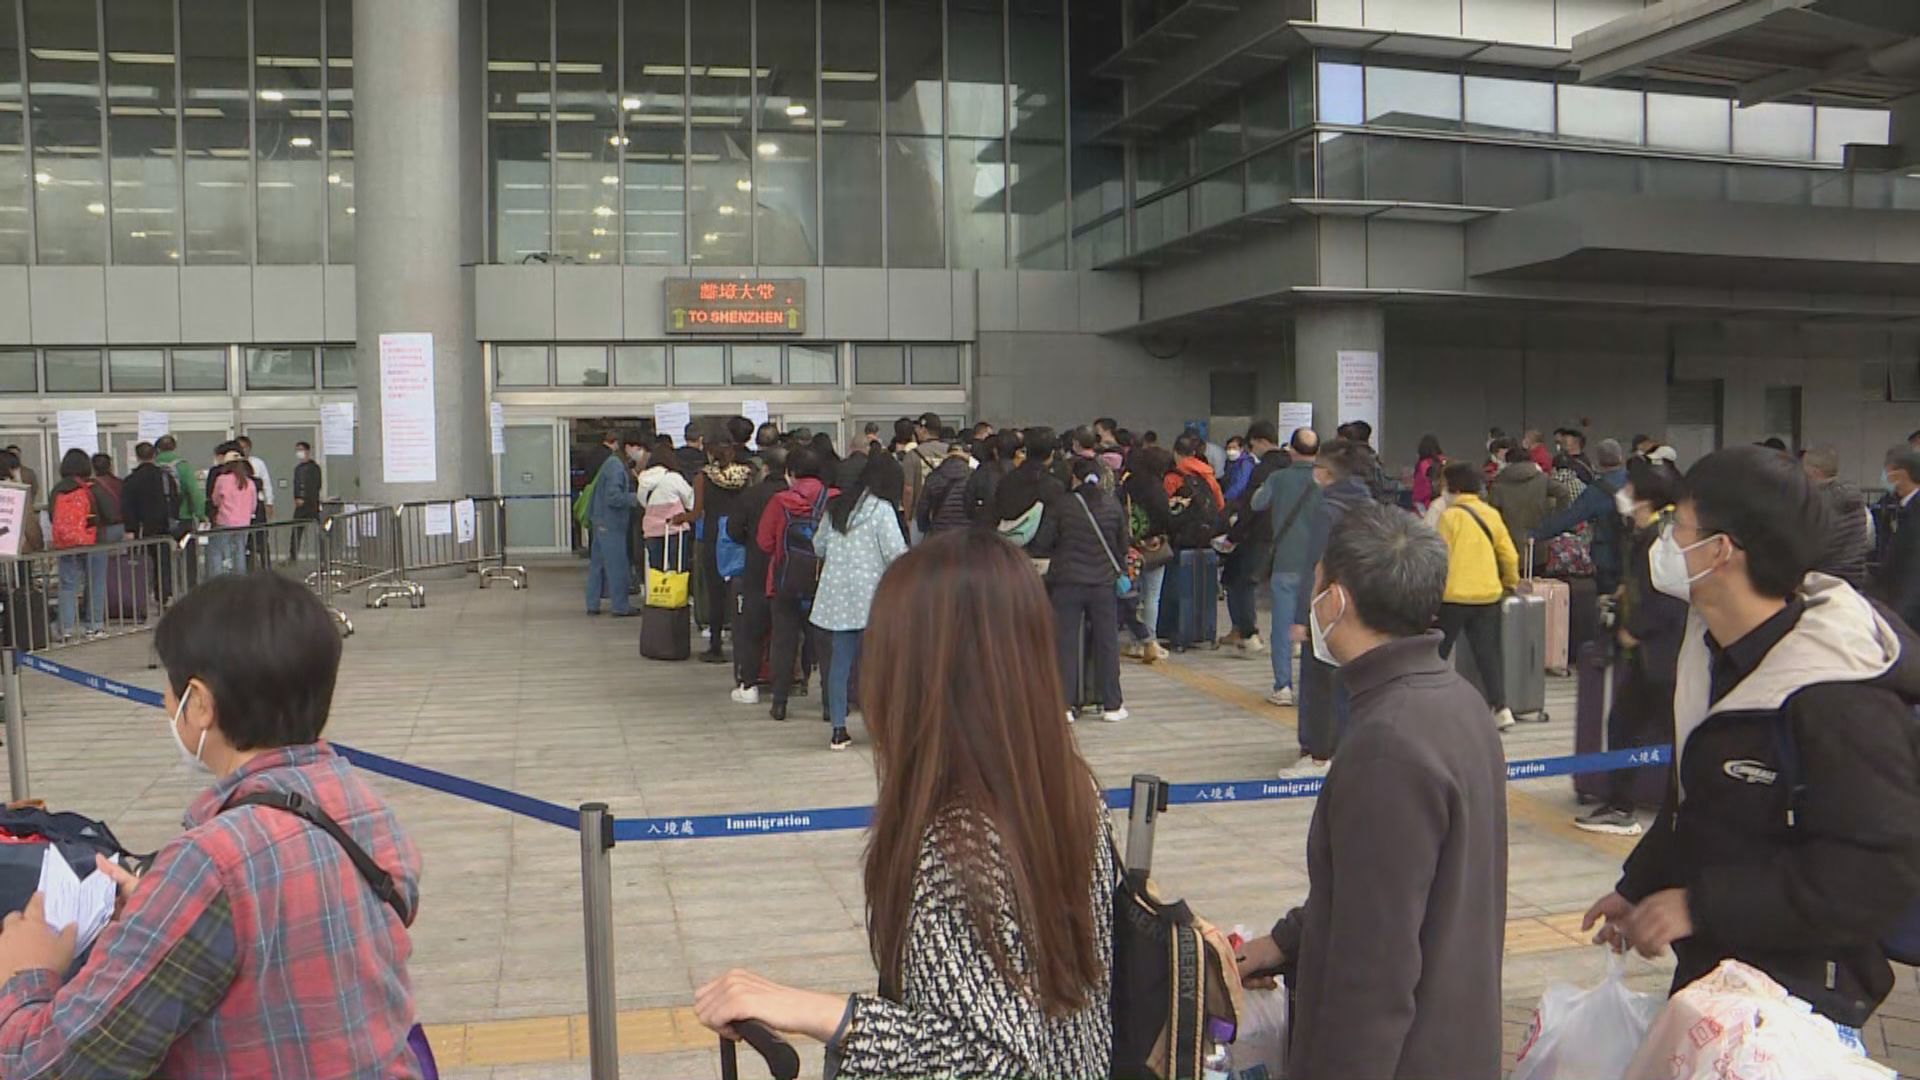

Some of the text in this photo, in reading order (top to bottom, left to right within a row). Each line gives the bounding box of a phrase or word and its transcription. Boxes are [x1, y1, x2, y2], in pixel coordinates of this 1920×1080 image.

[688, 310, 784, 324] TO SHENZHEN
[1506, 762, 1546, 777] igration
[1262, 780, 1322, 796] Immigrati
[647, 819, 695, 836] 入境處
[726, 814, 811, 831] Immigration
